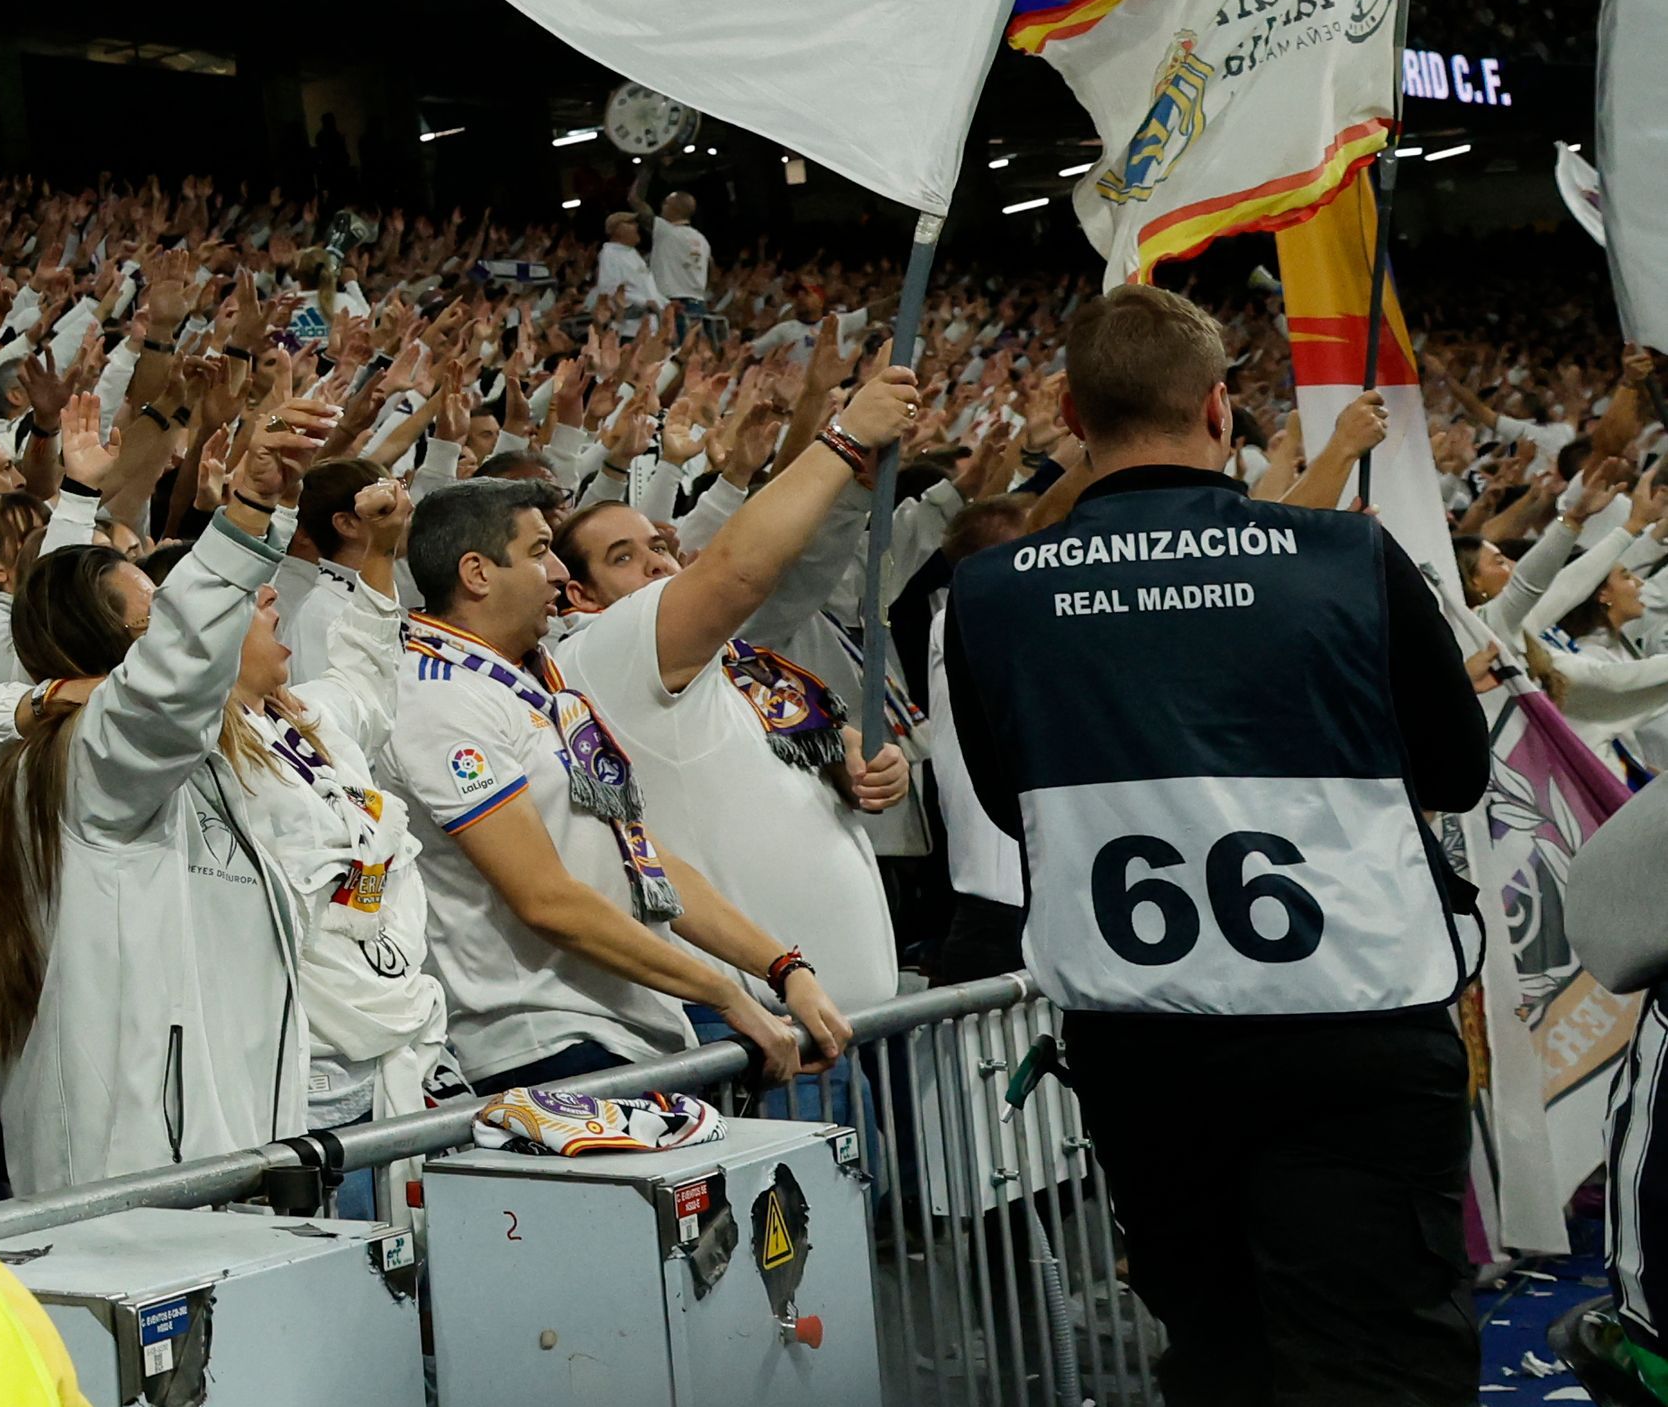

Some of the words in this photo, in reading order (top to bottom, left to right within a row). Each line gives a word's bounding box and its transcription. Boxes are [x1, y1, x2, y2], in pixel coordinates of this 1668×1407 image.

[1013, 521, 1298, 572] ORGANIZACIÓN
[1054, 589, 1129, 617] REAL
[1137, 583, 1255, 612] MADRID
[461, 777, 494, 795] LaLiga
[1091, 831, 1325, 966] 66
